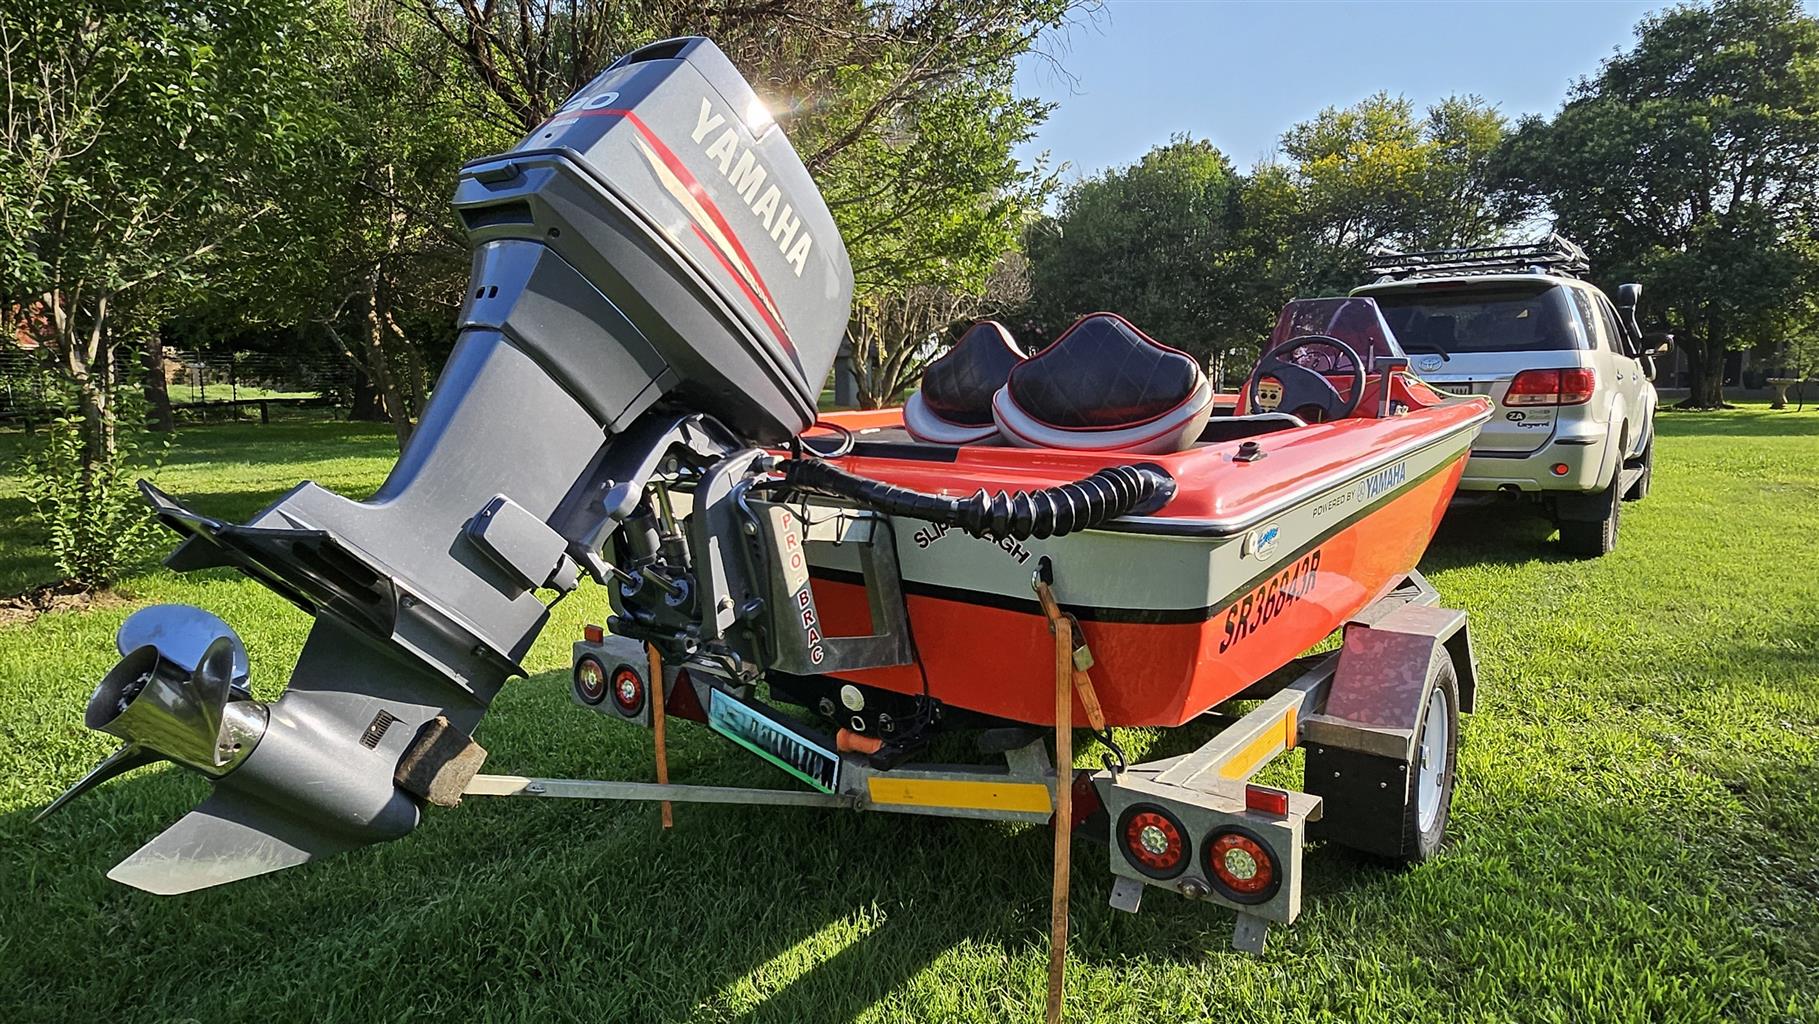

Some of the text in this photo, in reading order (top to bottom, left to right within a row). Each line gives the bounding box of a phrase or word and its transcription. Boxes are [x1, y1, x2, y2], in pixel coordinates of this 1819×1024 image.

[690, 96, 813, 278] YAMAHA
[1509, 412, 1523, 420] ZA
[1312, 462, 1405, 518] POWERED BY YAMAHA
[1219, 550, 1320, 654] SR36843R
